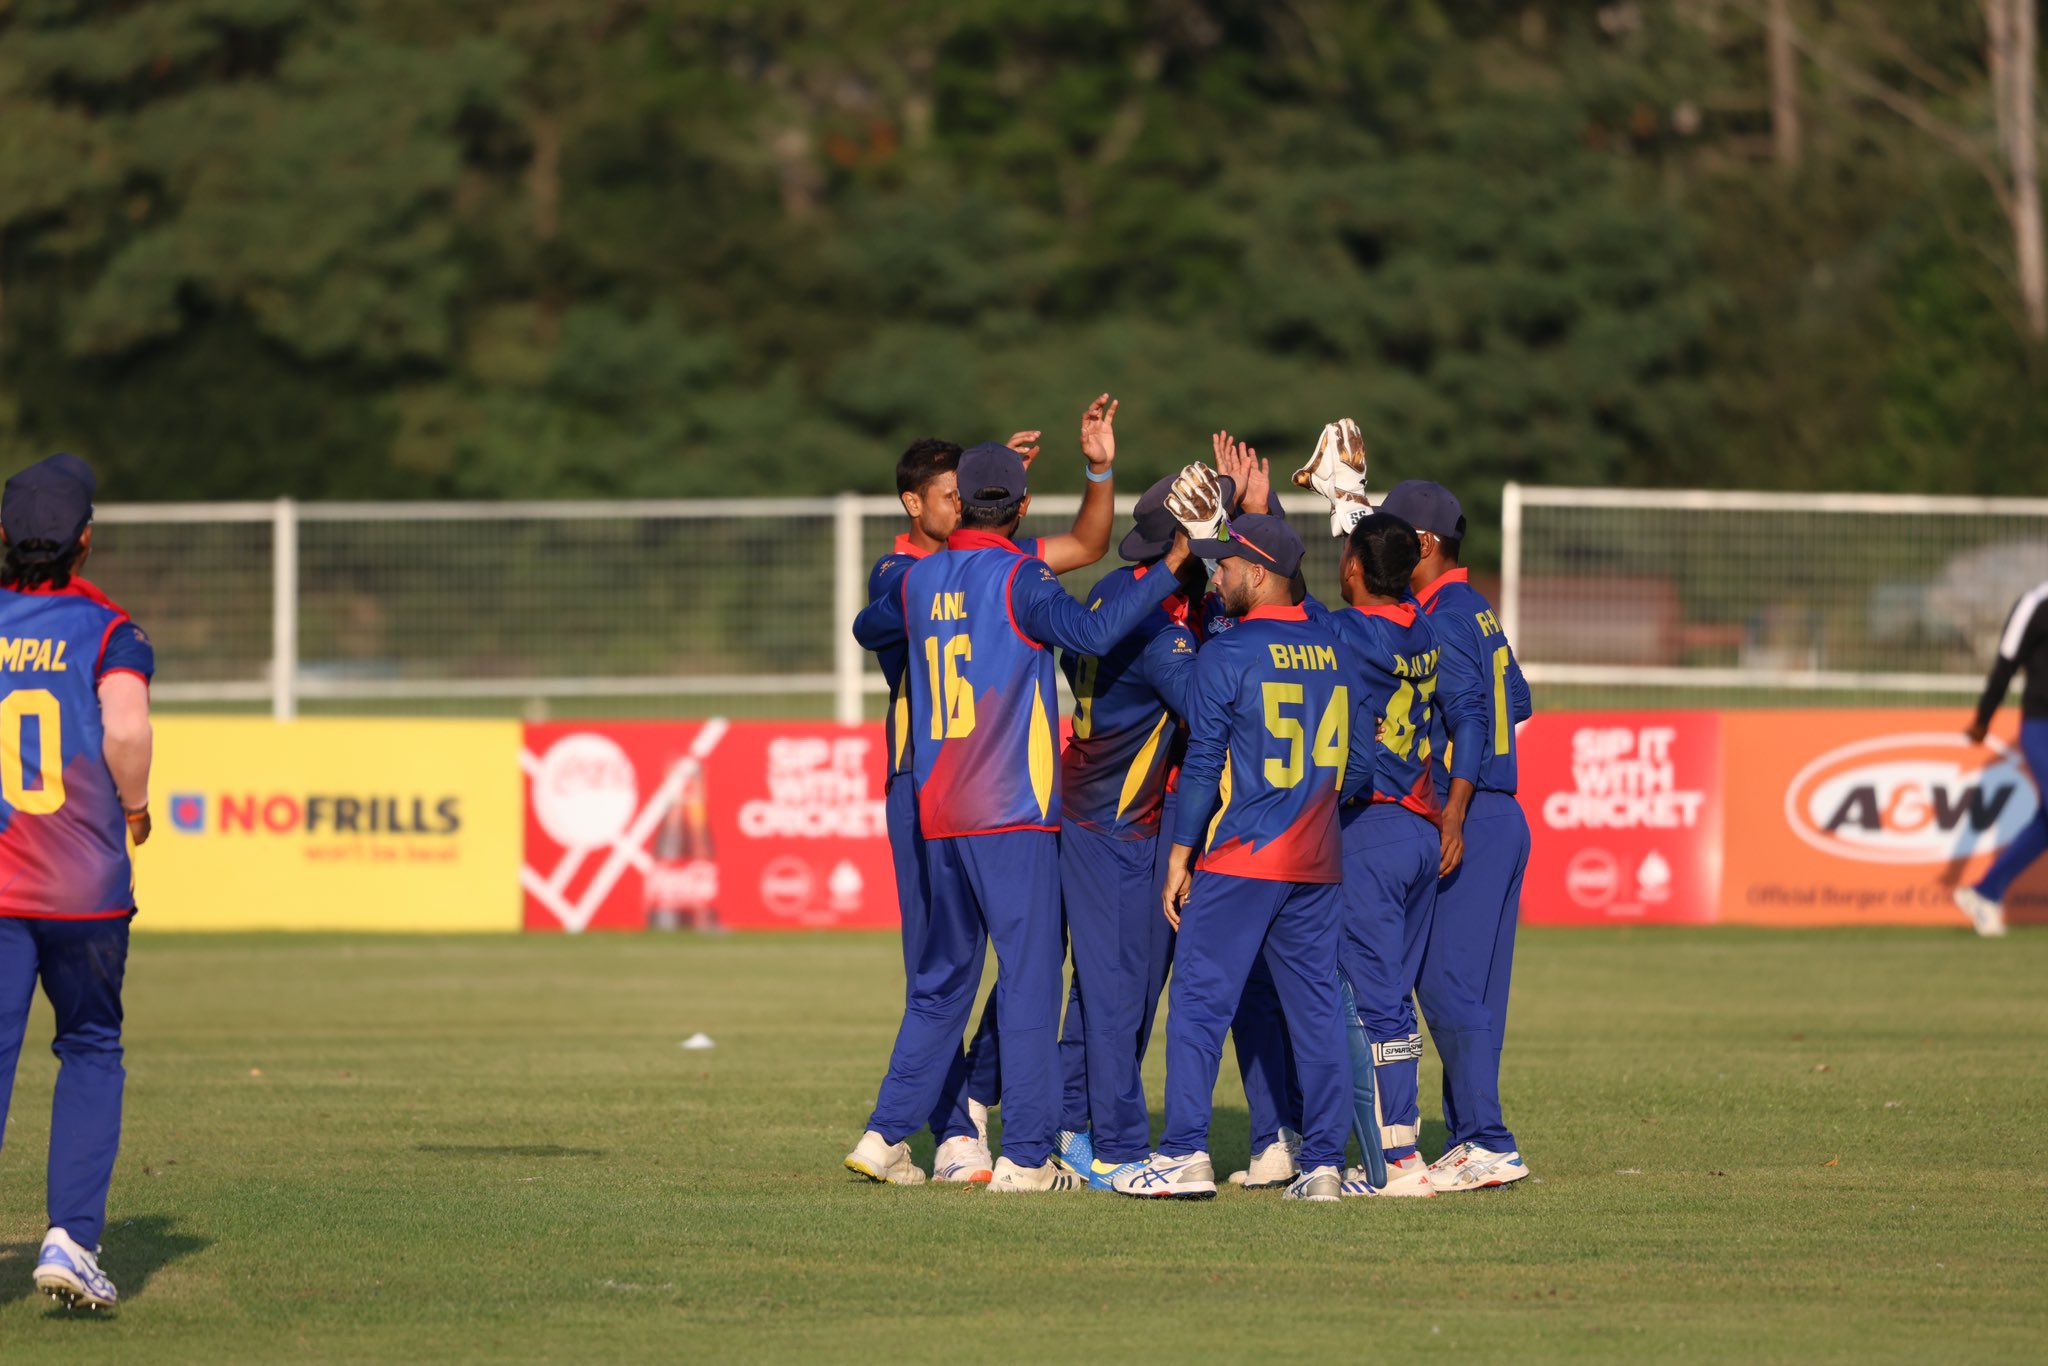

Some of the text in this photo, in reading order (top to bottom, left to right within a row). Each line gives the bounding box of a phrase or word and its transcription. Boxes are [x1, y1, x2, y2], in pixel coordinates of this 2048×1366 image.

[0, 637, 67, 672] MPAL
[925, 634, 976, 740] 16
[1268, 644, 1338, 670] BHIM
[0, 688, 66, 815] 0
[1261, 682, 1349, 791] 54
[1822, 781, 2017, 835] A&W
